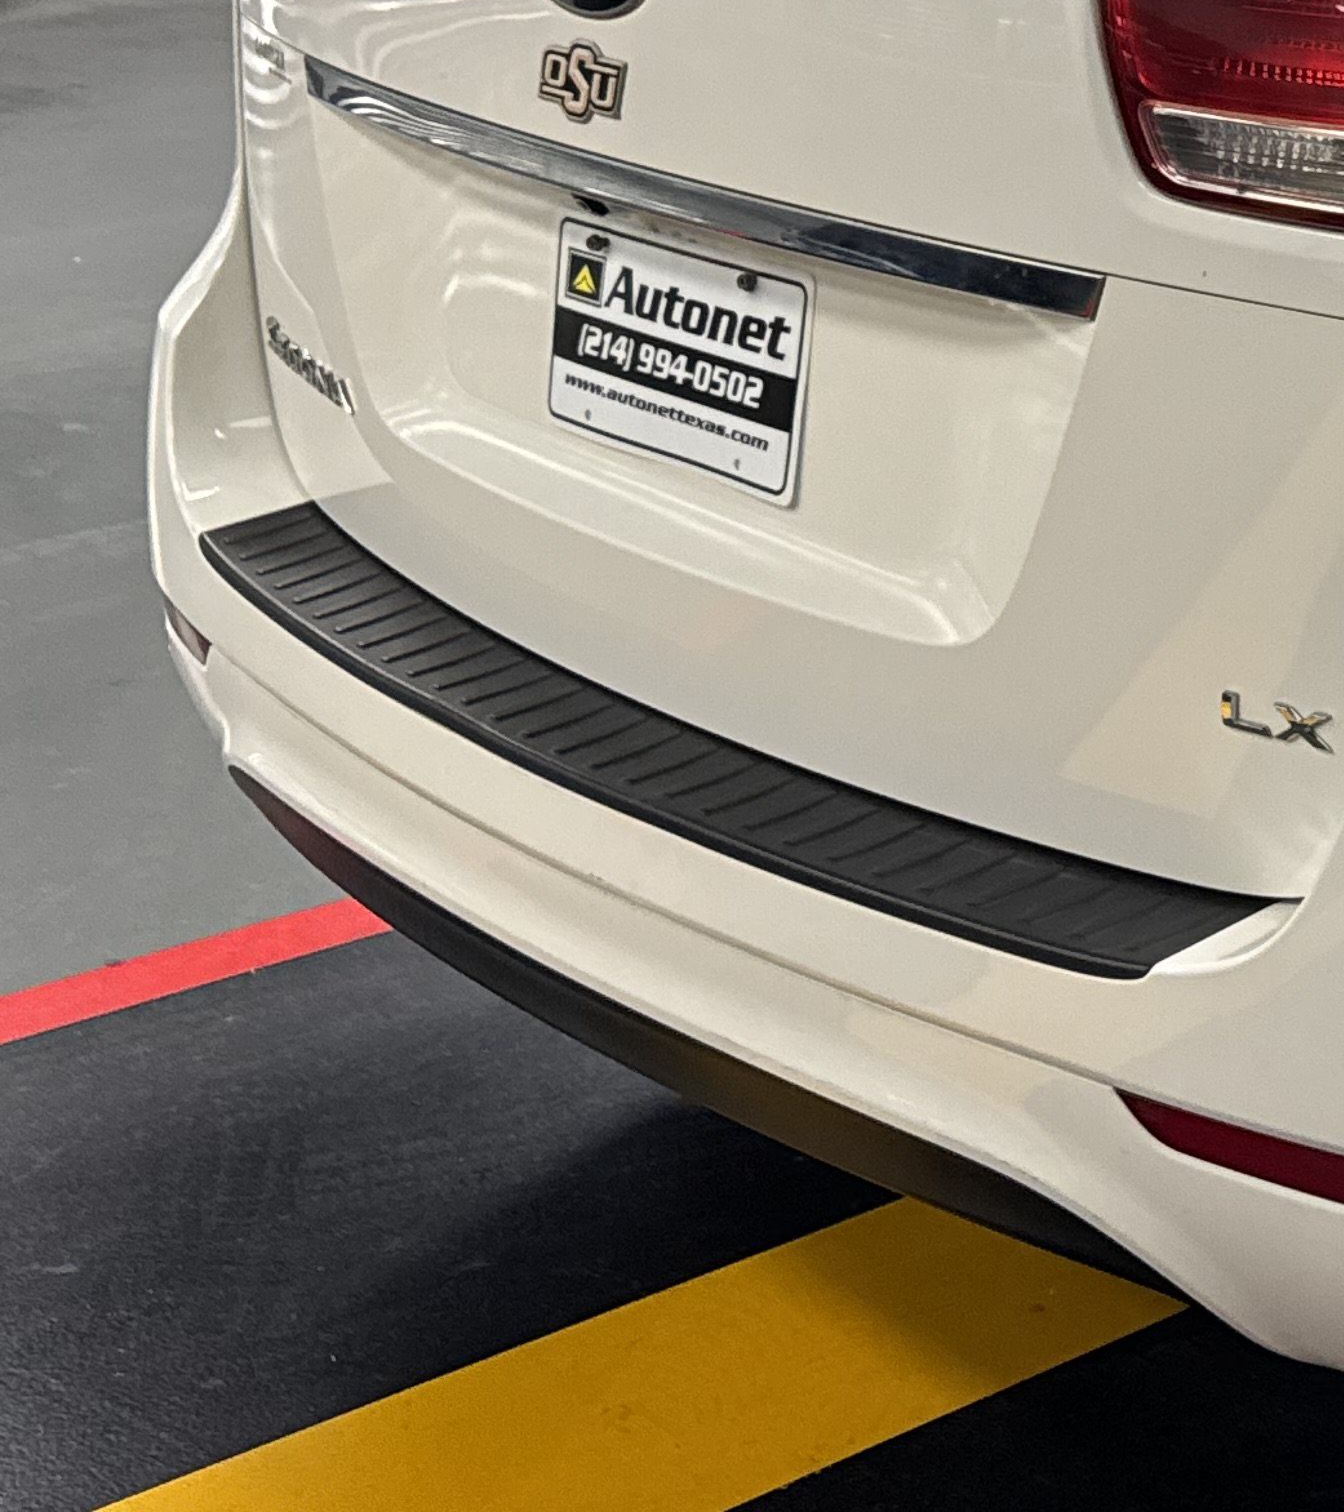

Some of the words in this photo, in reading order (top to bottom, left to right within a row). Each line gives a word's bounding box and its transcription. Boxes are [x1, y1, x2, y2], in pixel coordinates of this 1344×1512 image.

[540, 42, 623, 121] OSU
[604, 266, 792, 362] Autonet
[577, 324, 635, 373] (214)
[636, 341, 765, 409] 994-0502
[564, 372, 769, 452] www.autonettexas.com
[1220, 689, 1335, 755] LX
